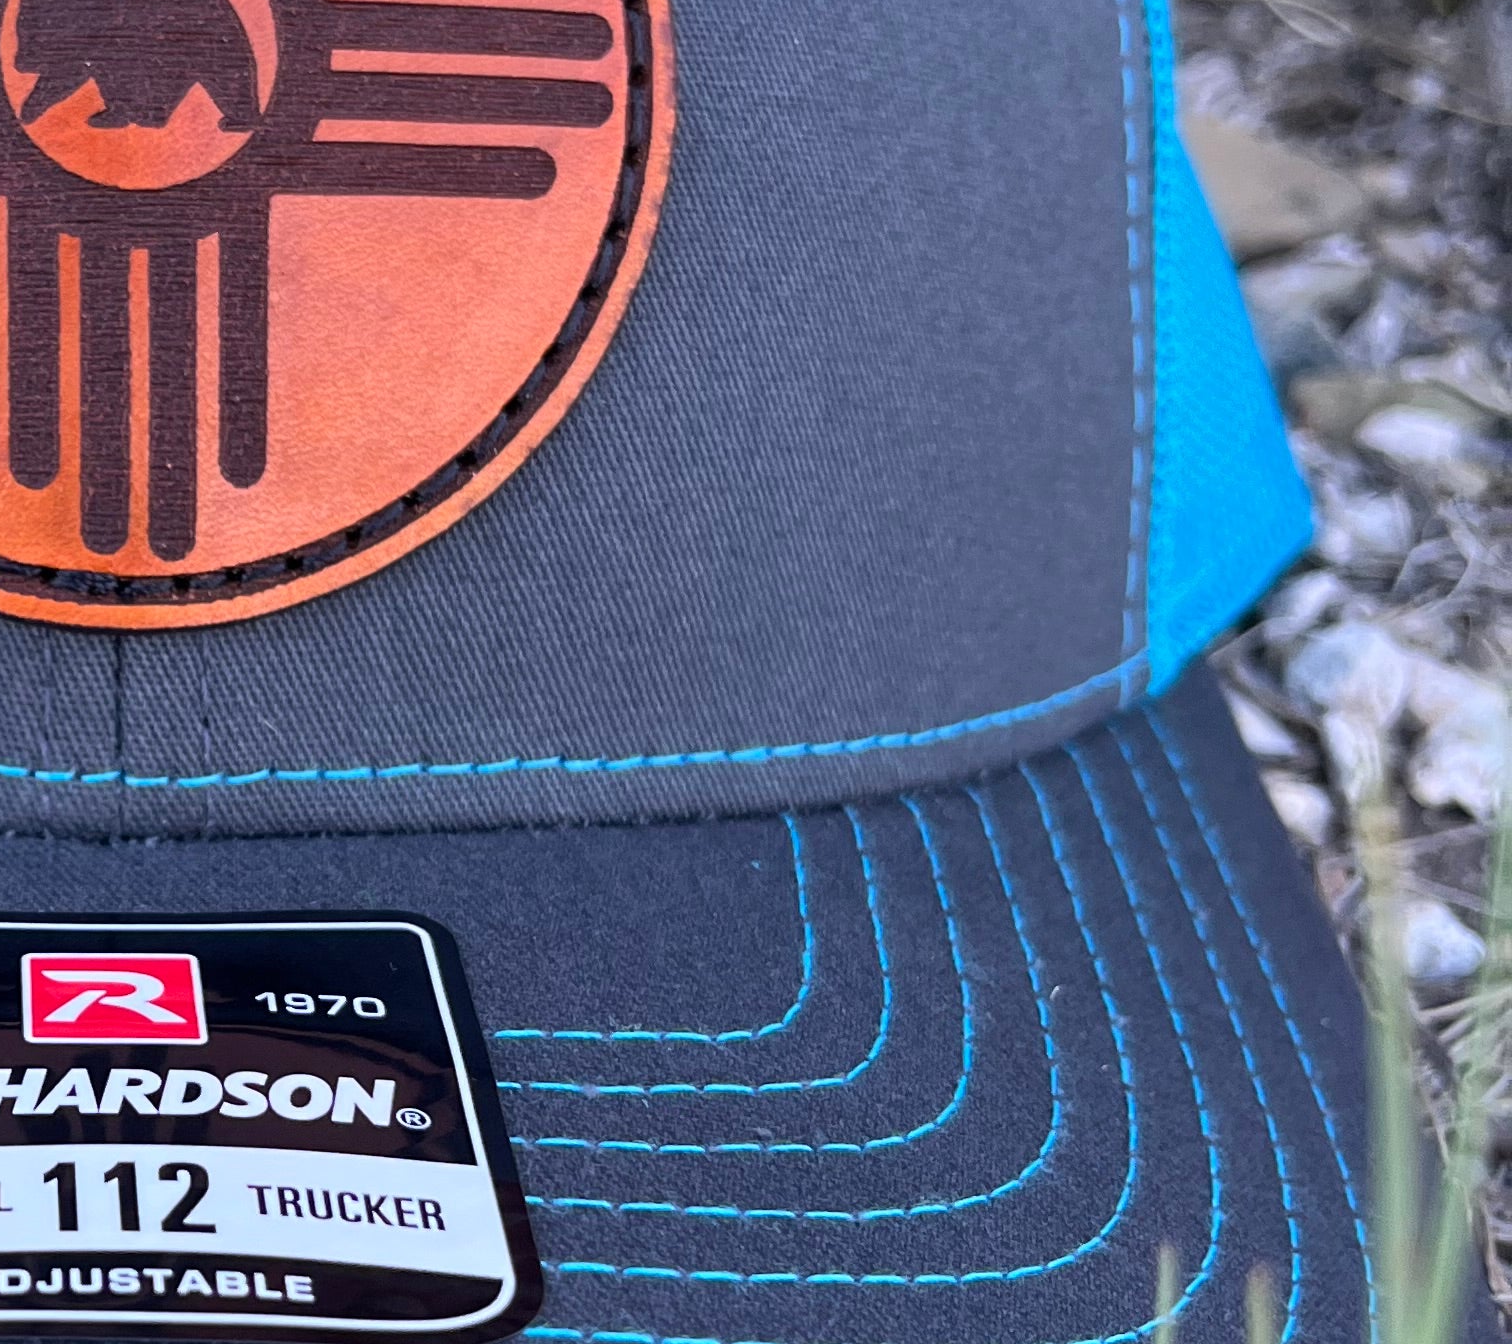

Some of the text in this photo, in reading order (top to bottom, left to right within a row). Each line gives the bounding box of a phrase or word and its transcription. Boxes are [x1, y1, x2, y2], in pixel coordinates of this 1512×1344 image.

[254, 991, 386, 1018] 1970
[43, 1161, 217, 1234] 112
[247, 1184, 446, 1231] TRUCKER
